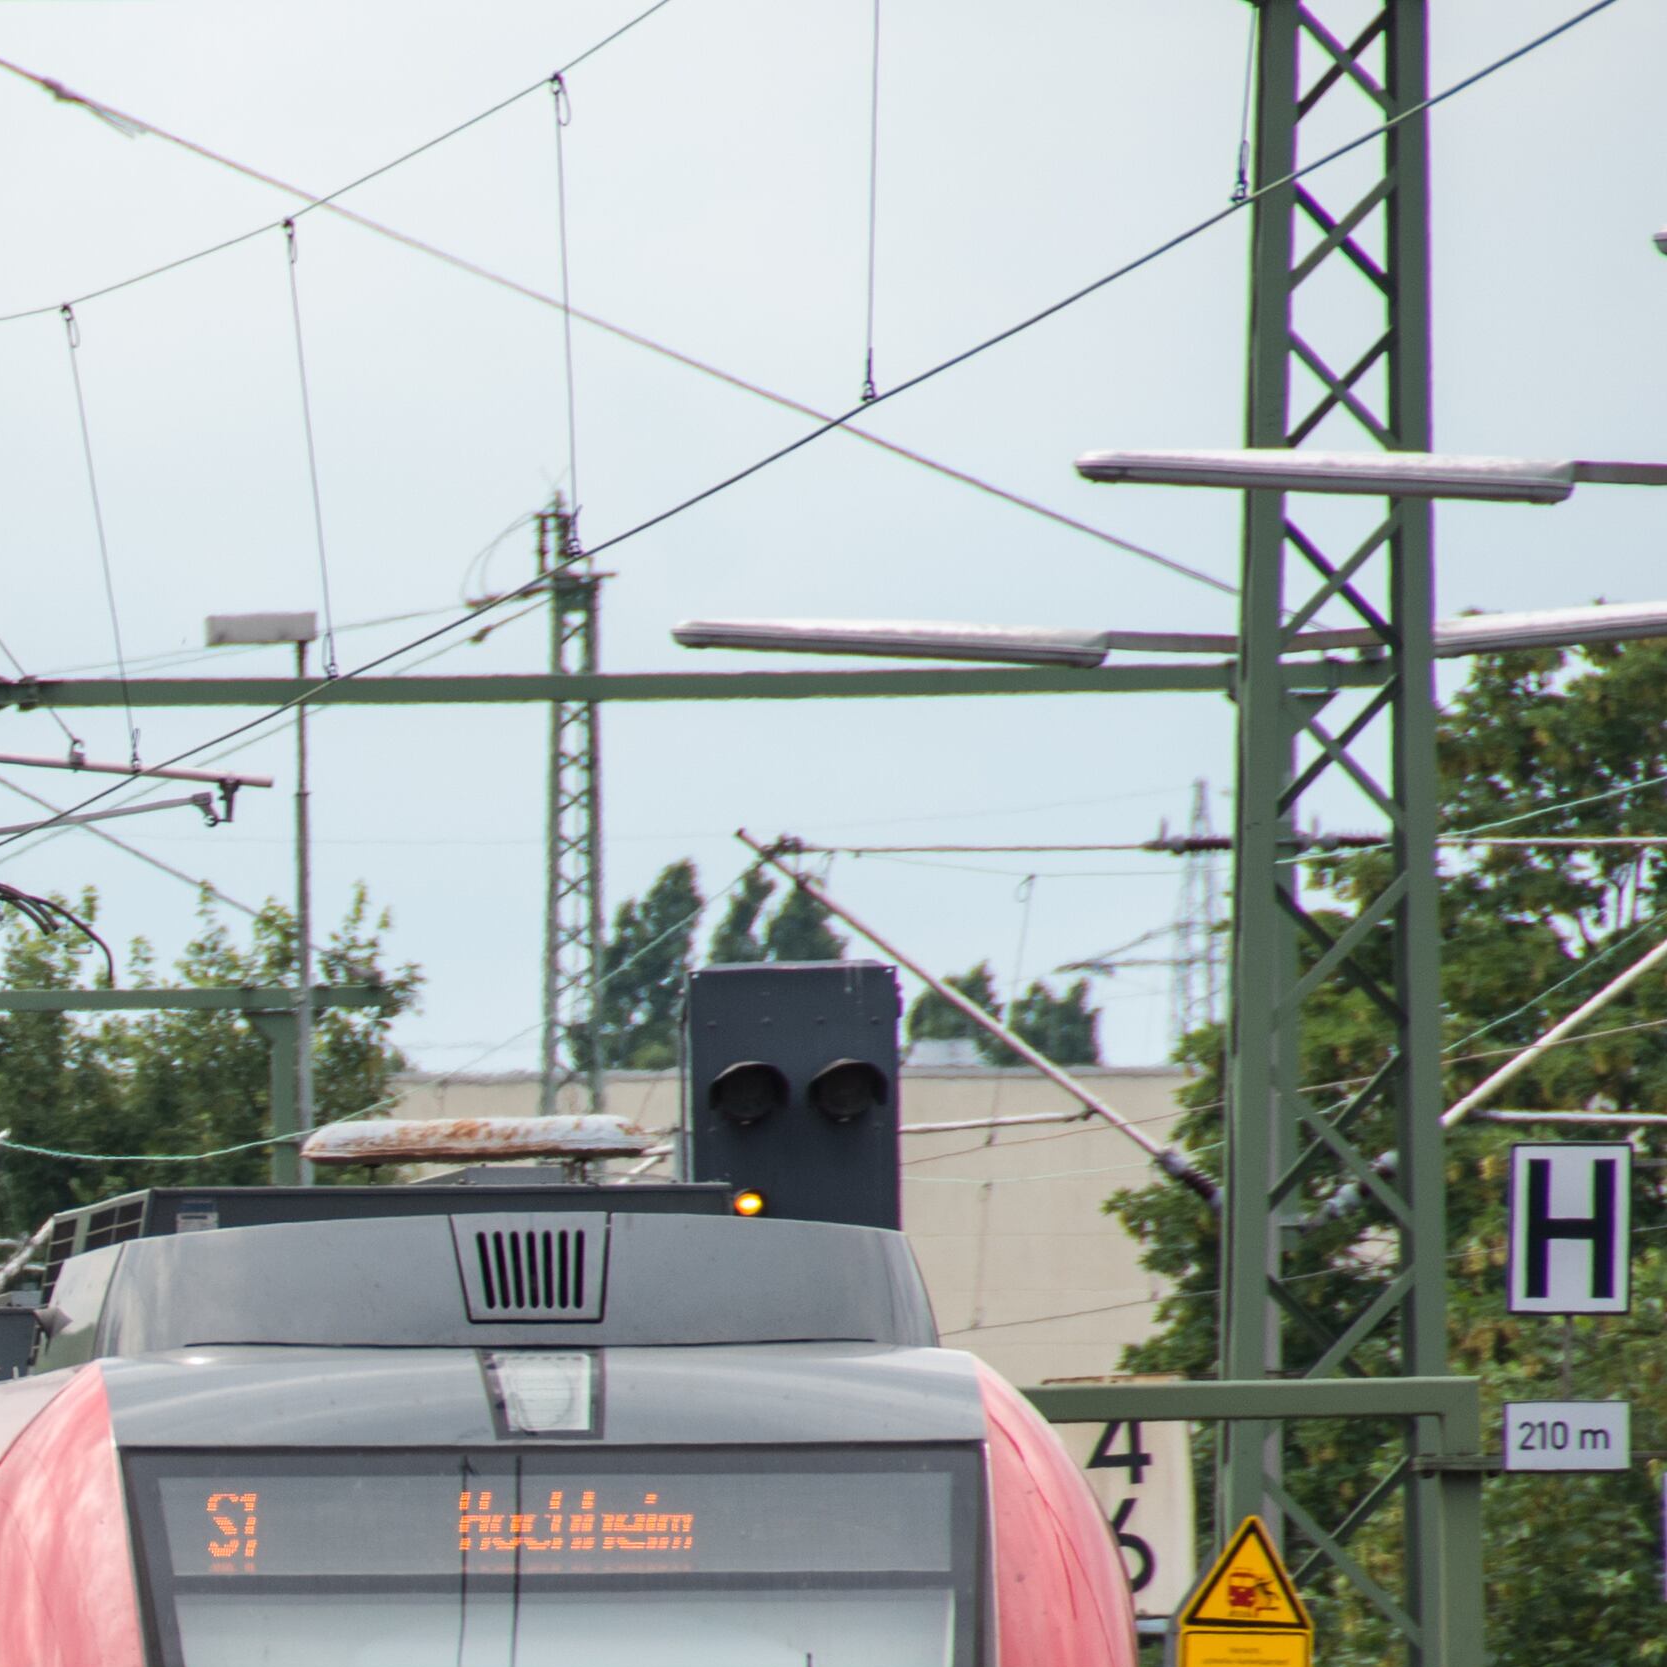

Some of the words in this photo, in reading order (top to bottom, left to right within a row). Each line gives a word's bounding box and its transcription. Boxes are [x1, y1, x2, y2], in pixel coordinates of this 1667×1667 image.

[1525, 1159, 1615, 1298] H
[1087, 1420, 1151, 1484] 4
[1518, 1421, 1568, 1450] 210
[1579, 1429, 1610, 1450] m
[207, 1493, 258, 1557] S1
[1111, 1498, 1155, 1594] 6
